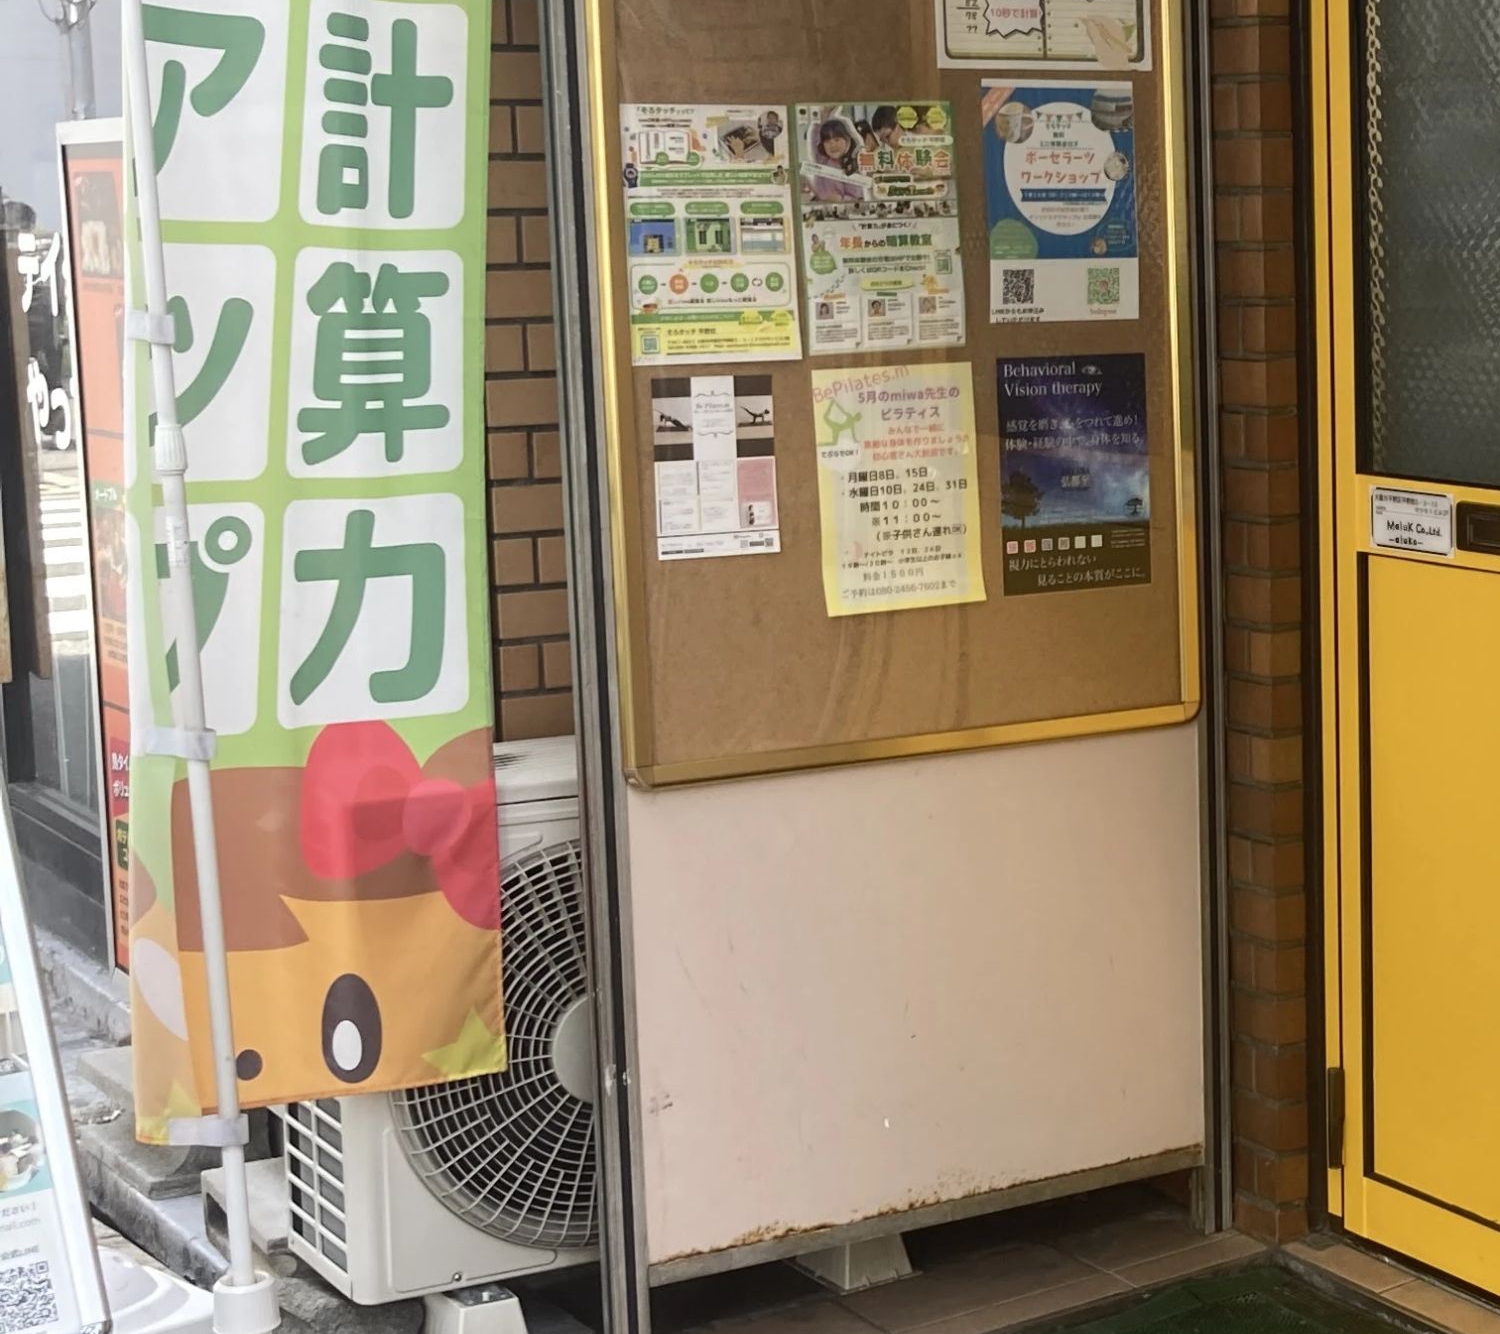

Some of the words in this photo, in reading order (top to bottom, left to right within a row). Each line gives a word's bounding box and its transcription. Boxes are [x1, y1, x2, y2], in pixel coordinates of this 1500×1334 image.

[290, 13, 454, 707] 計算力
[1003, 360, 1075, 378] Behavioral
[1004, 382, 1048, 397] Vision
[1051, 381, 1102, 397] therapy
